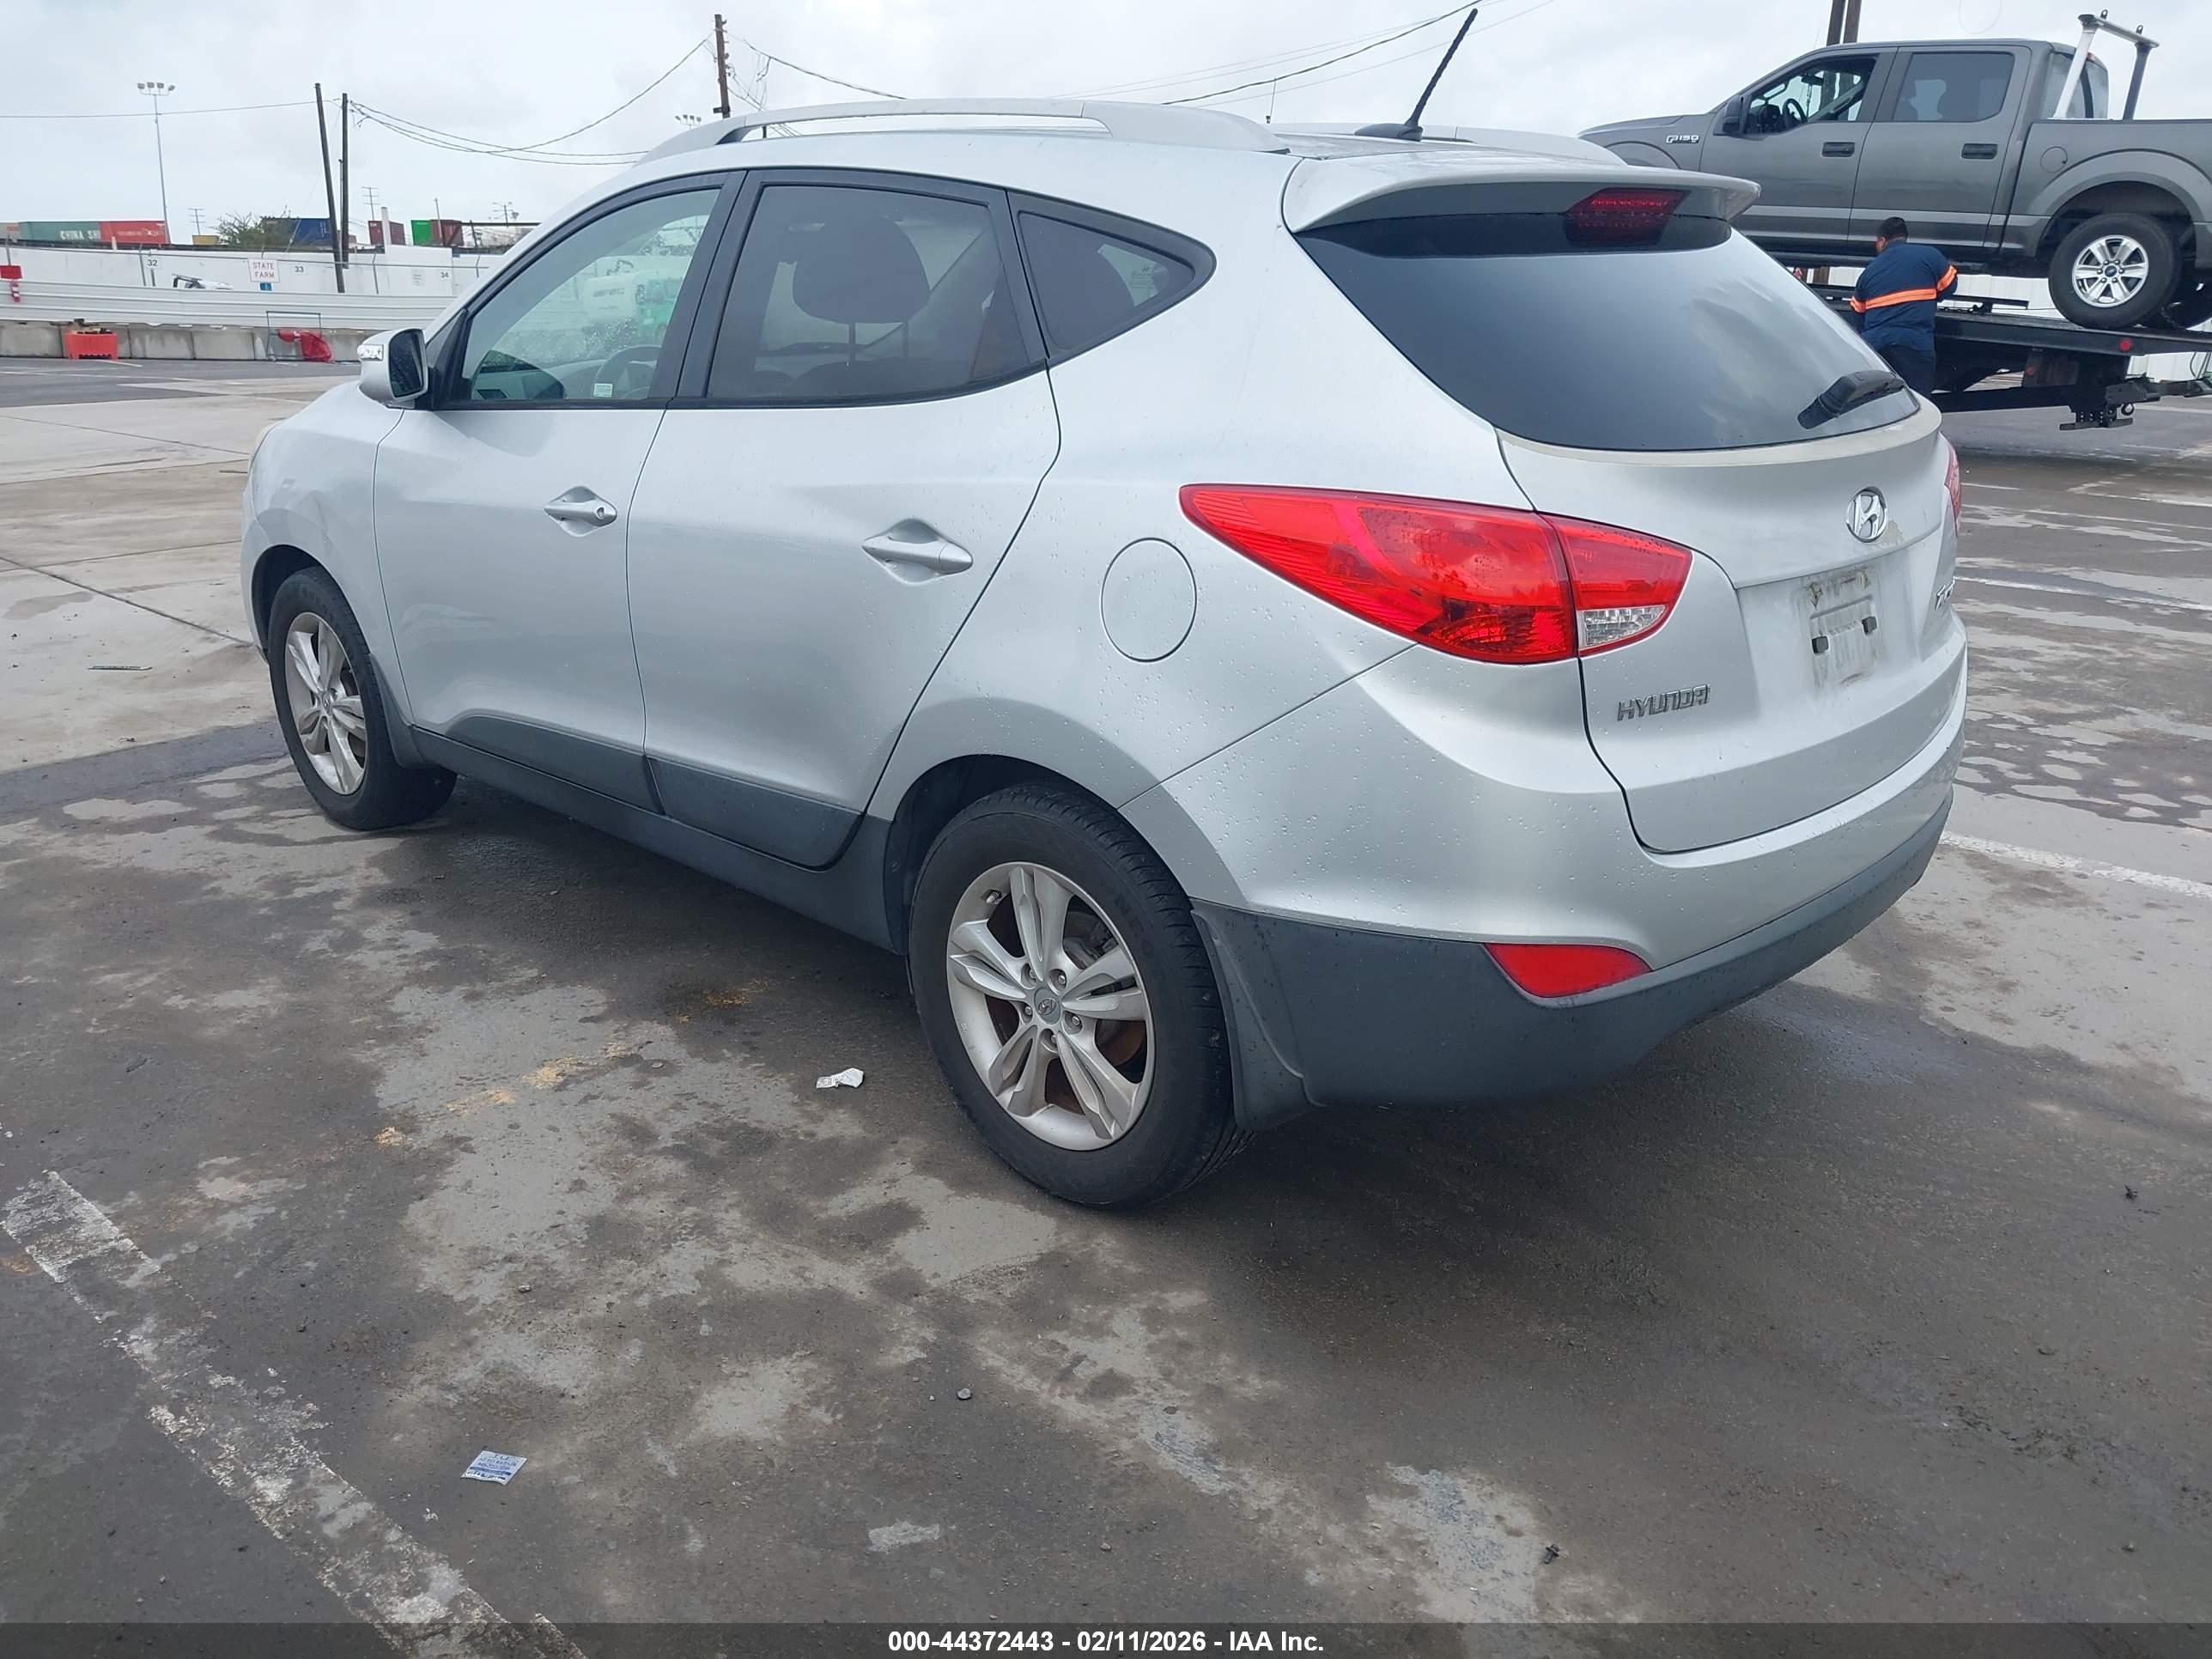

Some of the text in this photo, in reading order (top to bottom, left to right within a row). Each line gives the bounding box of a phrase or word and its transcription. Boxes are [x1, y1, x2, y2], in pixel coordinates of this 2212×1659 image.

[60, 229, 84, 240] CHINA
[252, 261, 275, 270] STATE
[1618, 684, 1711, 721] HYUNDAI
